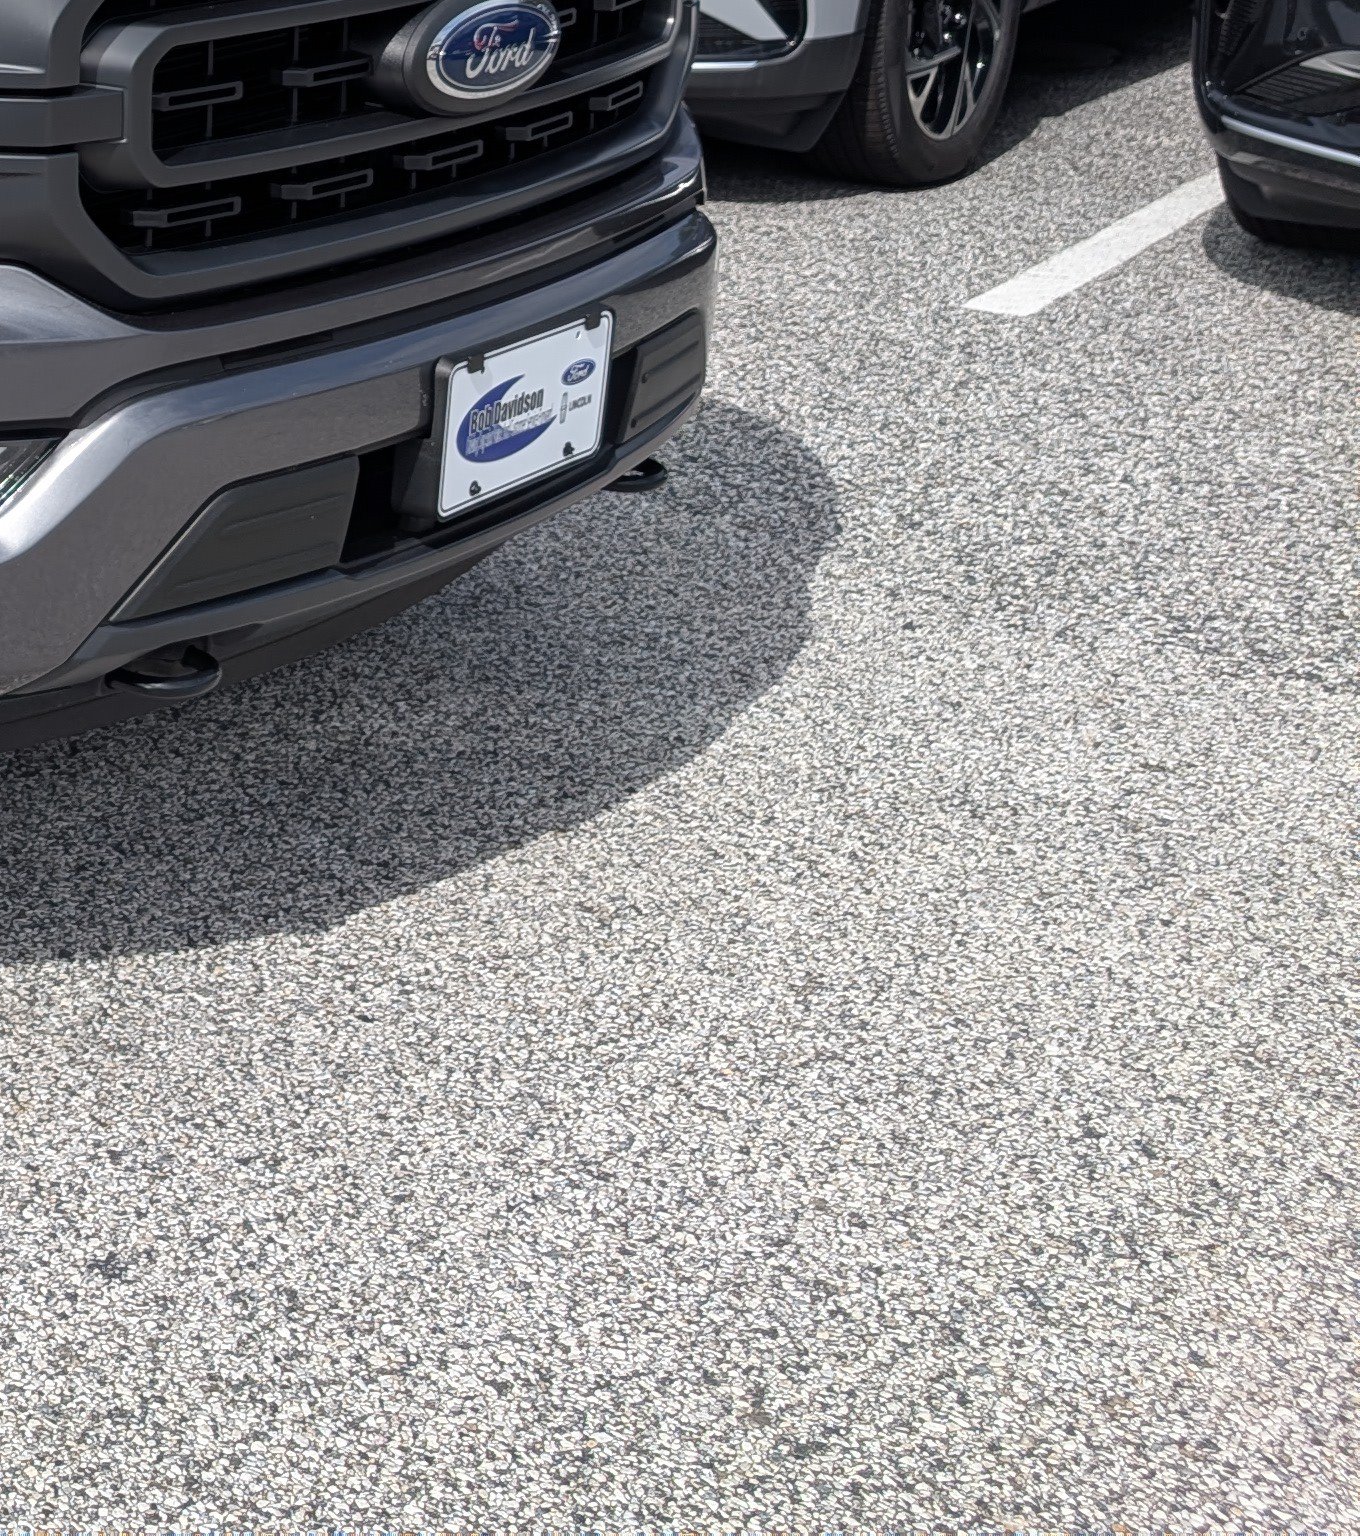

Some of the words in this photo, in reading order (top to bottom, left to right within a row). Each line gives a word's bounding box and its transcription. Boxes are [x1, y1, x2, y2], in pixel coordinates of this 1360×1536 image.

[465, 19, 536, 79] Ford
[469, 404, 494, 437] Bob
[494, 388, 544, 425] Davidson
